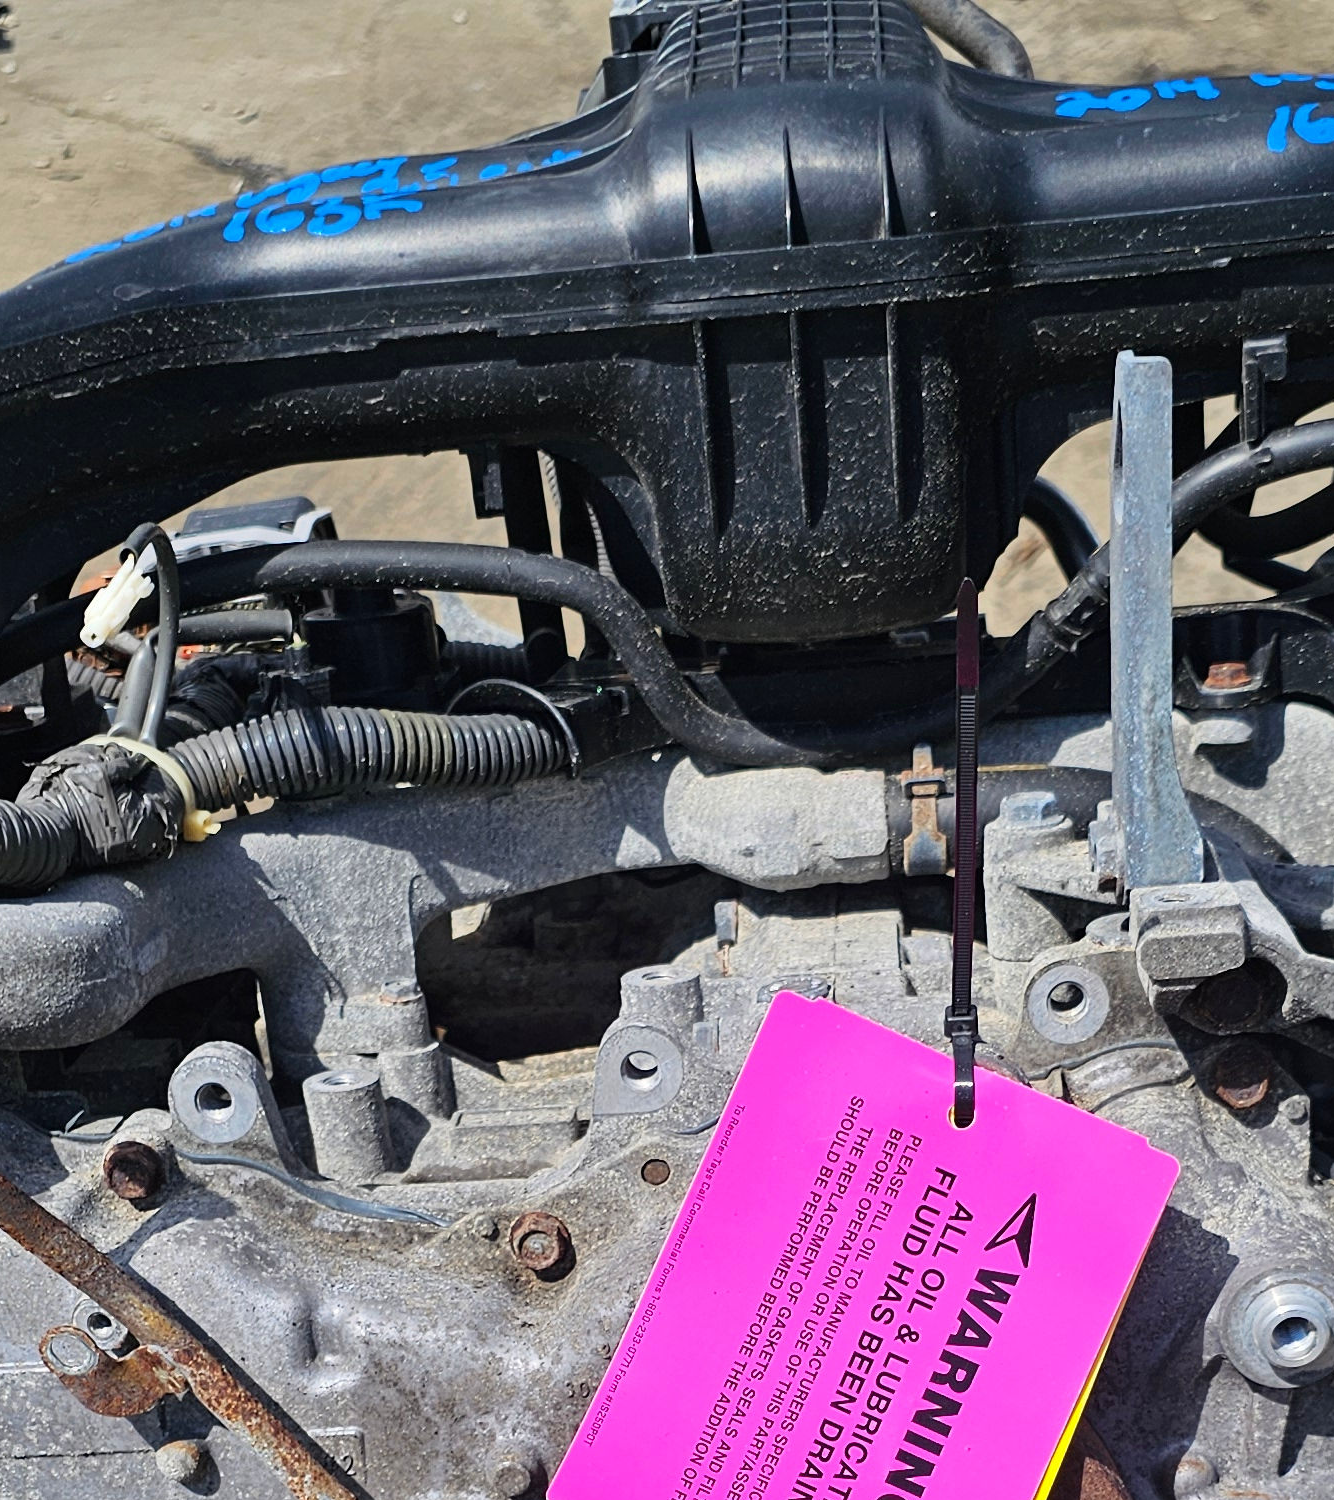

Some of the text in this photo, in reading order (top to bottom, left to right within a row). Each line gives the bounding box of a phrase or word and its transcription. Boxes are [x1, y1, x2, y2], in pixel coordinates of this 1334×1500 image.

[1054, 76, 1221, 119] 2014
[826, 1095, 865, 1164] SHOULD
[848, 1127, 874, 1160] THE
[813, 1165, 834, 1190] BE
[864, 1127, 904, 1196] BEFORE
[884, 1134, 923, 1200] PLEASE
[796, 1160, 858, 1281] REPLACEMENT
[867, 1200, 893, 1233] FILL
[901, 1166, 958, 1257] FLUID
[931, 1199, 974, 1258] ALL
[769, 1190, 823, 1290] PERFORMED
[821, 1197, 872, 1291] OPERATION
[854, 1237, 876, 1262] OIL
[786, 1281, 804, 1306] OF
[844, 1268, 864, 1290] TO
[870, 1260, 915, 1326] HAS
[906, 1268, 946, 1314] OIL
[738, 1291, 778, 1358] BEFORE
[809, 1292, 830, 1317] OR
[745, 1306, 792, 1382] GASKETS,
[794, 1318, 819, 1353] USE
[893, 1323, 920, 1345] &
[723, 1360, 748, 1392] THE
[780, 1291, 853, 1433] MANUFACTURERS
[785, 1354, 802, 1379] OF
[829, 1329, 884, 1416] BEEN
[724, 1386, 756, 1439] SEALS
[766, 1380, 793, 1415] THIS
[689, 1391, 731, 1467] ADDITION
[680, 1467, 698, 1490] OF
[708, 1438, 732, 1474] AND
